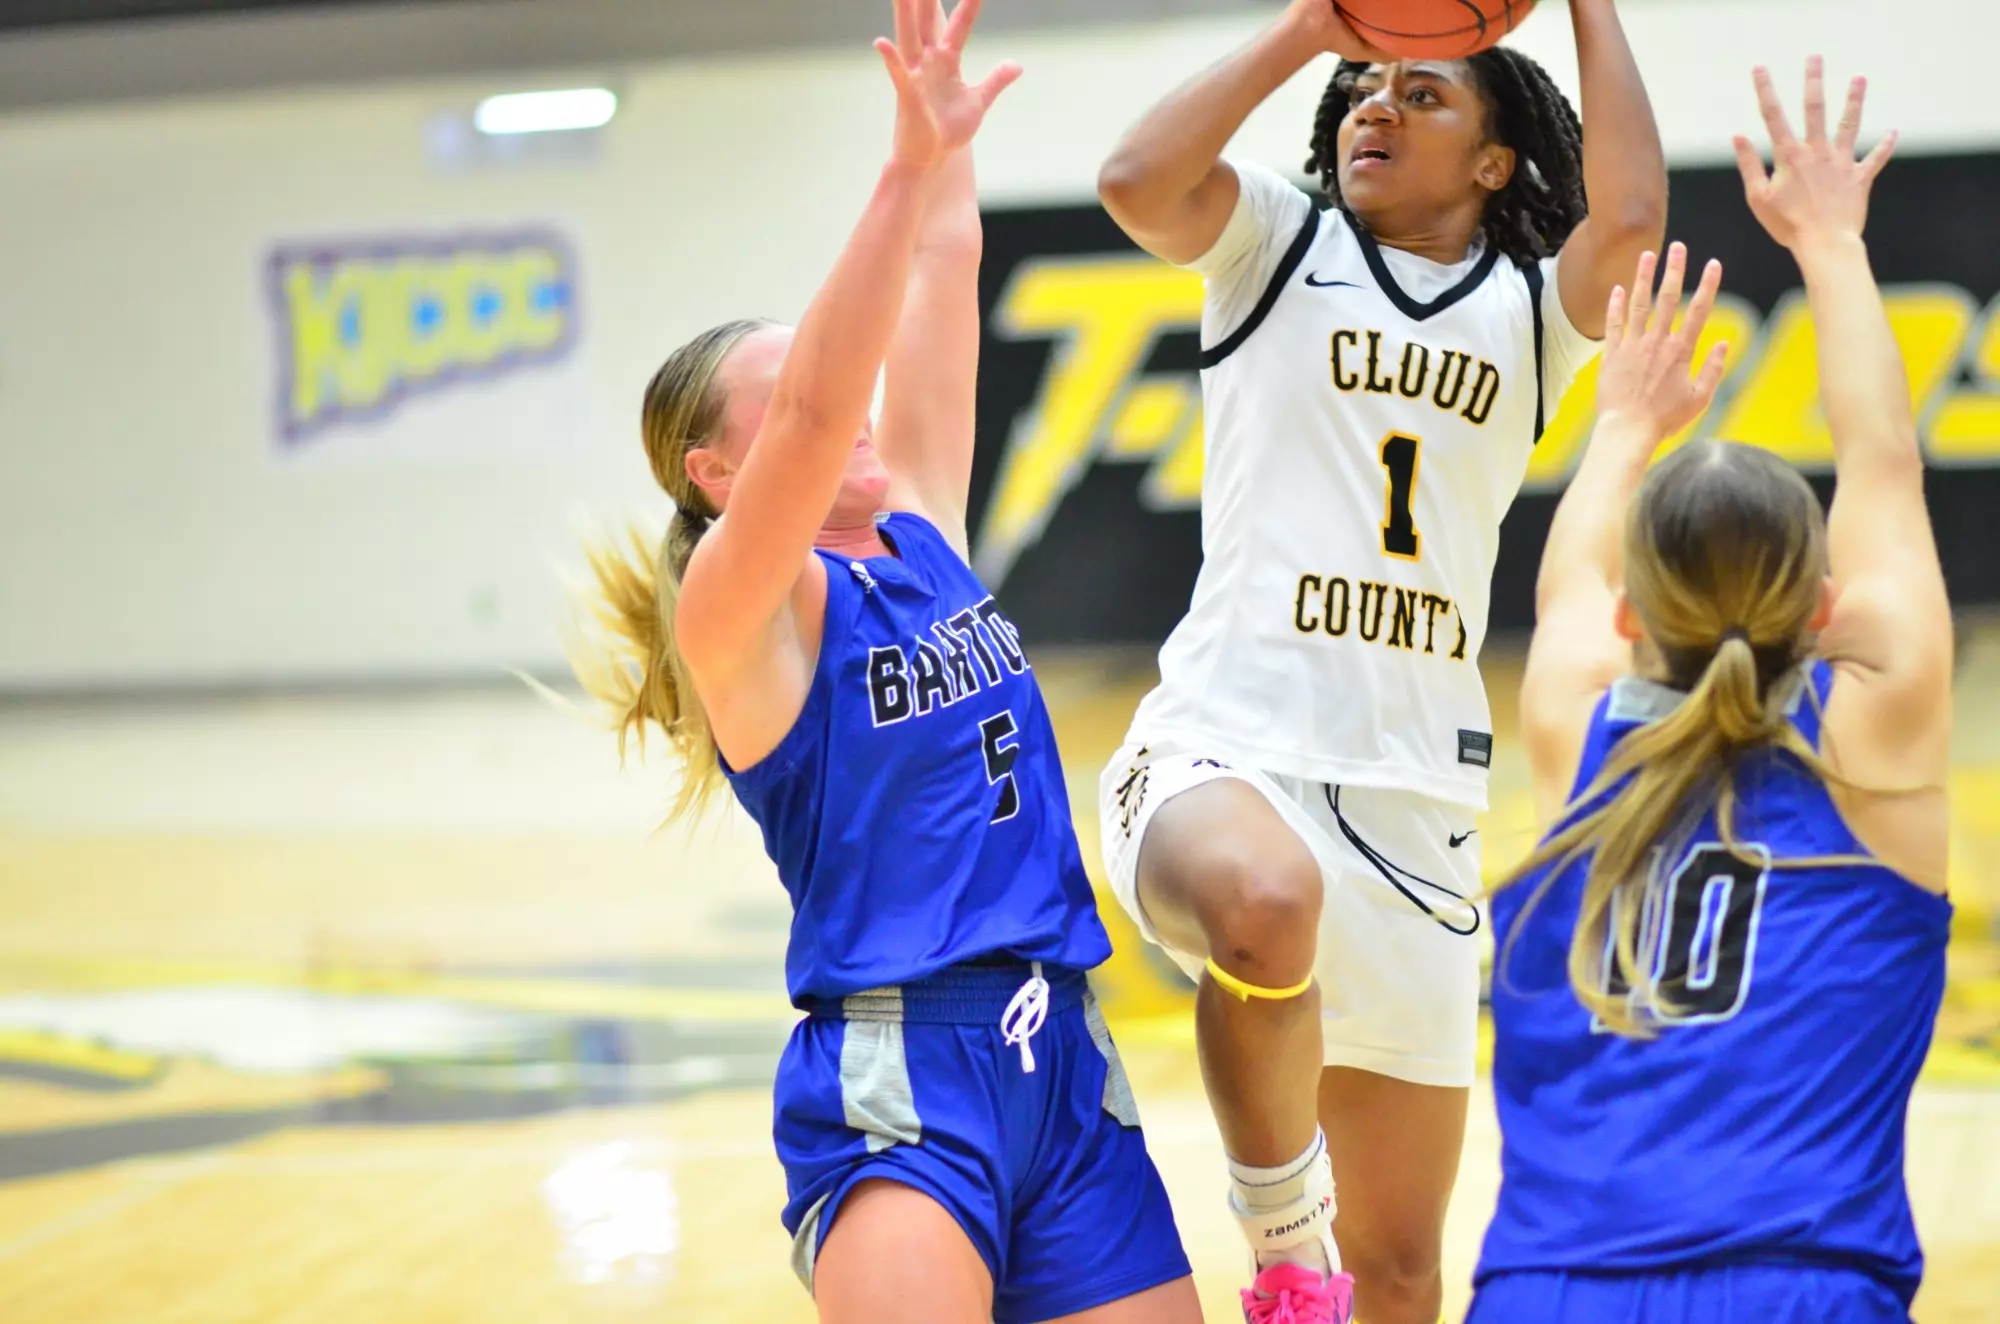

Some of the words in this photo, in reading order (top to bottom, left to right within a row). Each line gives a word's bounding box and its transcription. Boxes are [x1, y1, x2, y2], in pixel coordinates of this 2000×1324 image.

[1329, 328, 1502, 427] CLOUD
[1378, 430, 1423, 563] 1
[867, 594, 1032, 728] BARTO
[977, 708, 1021, 826] 5
